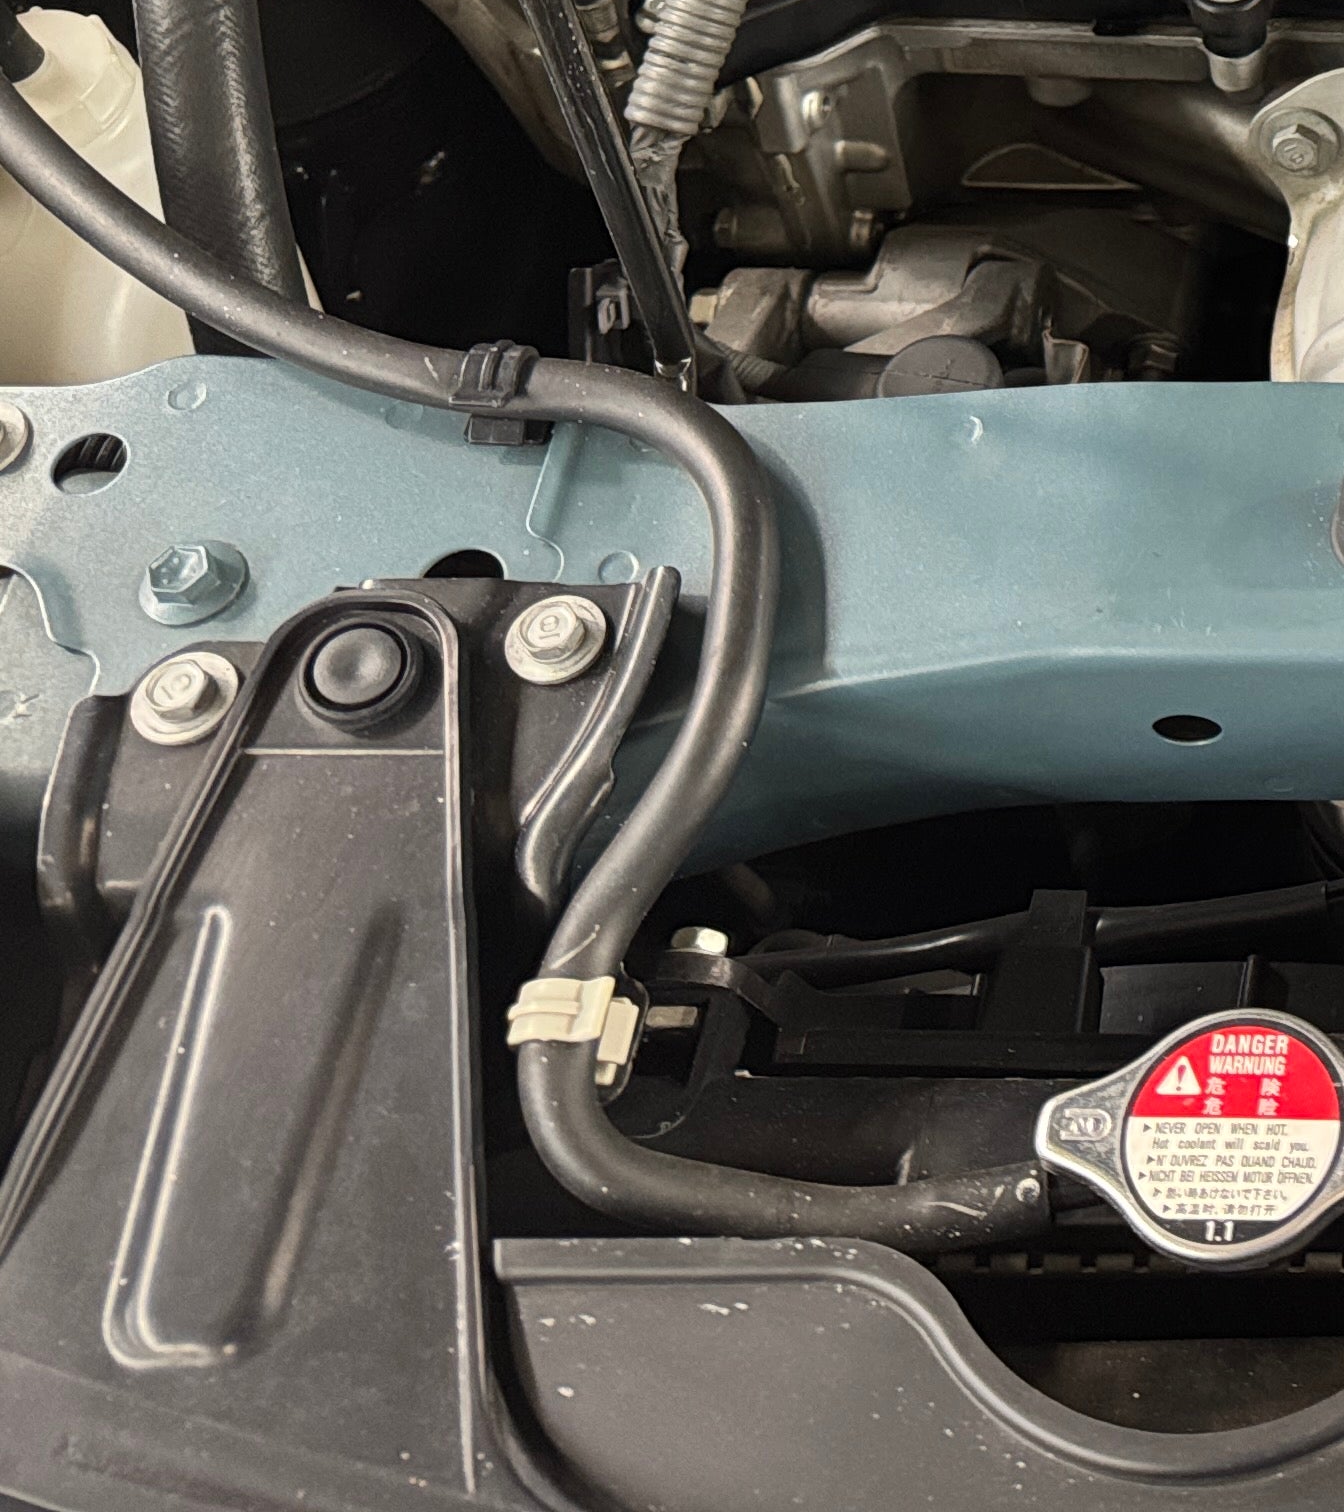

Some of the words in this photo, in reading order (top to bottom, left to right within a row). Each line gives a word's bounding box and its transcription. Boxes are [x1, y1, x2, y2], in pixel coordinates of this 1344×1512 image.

[1211, 1034, 1289, 1055] DANGER
[1209, 1055, 1287, 1076] WARNUNG
[1155, 1122, 1187, 1135] NEVER
[1194, 1122, 1222, 1135] OPEN
[1230, 1122, 1259, 1136] WHEN
[1265, 1123, 1289, 1136] HOT.
[1151, 1137, 1170, 1150] Hot
[1177, 1138, 1217, 1151] coolant
[1225, 1138, 1244, 1151] will
[1252, 1139, 1281, 1152] scald
[1289, 1141, 1309, 1154] you.
[1215, 1155, 1235, 1167] PAS
[1149, 1170, 1176, 1182] NICHT
[1179, 1170, 1195, 1183] BEI
[1242, 1171, 1274, 1184] MOTOR
[1204, 1220, 1235, 1243] 1.1
